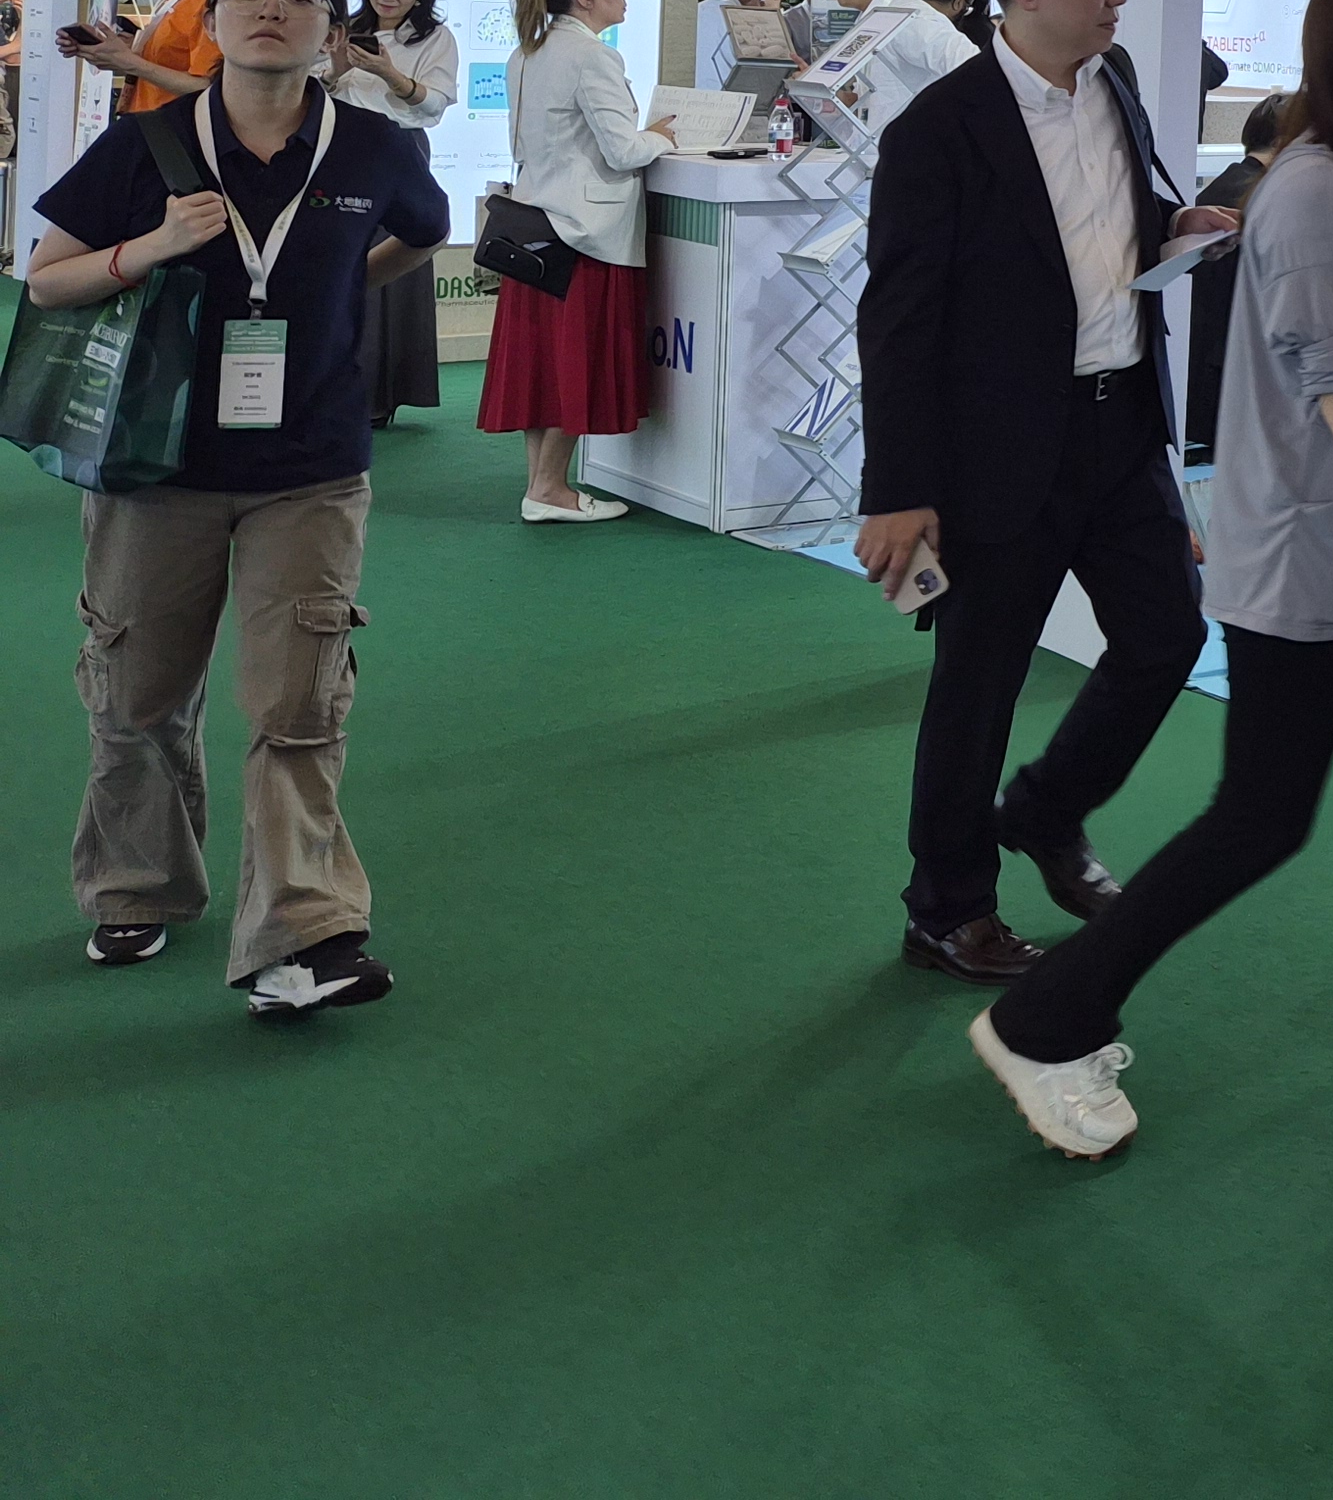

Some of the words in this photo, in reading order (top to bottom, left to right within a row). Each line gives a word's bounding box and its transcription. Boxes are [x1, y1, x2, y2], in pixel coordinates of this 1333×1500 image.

[1226, 61, 1251, 73] ltimate
[1277, 63, 1303, 77] Partne
[436, 276, 475, 300] DAS
[652, 317, 695, 374] o.N
